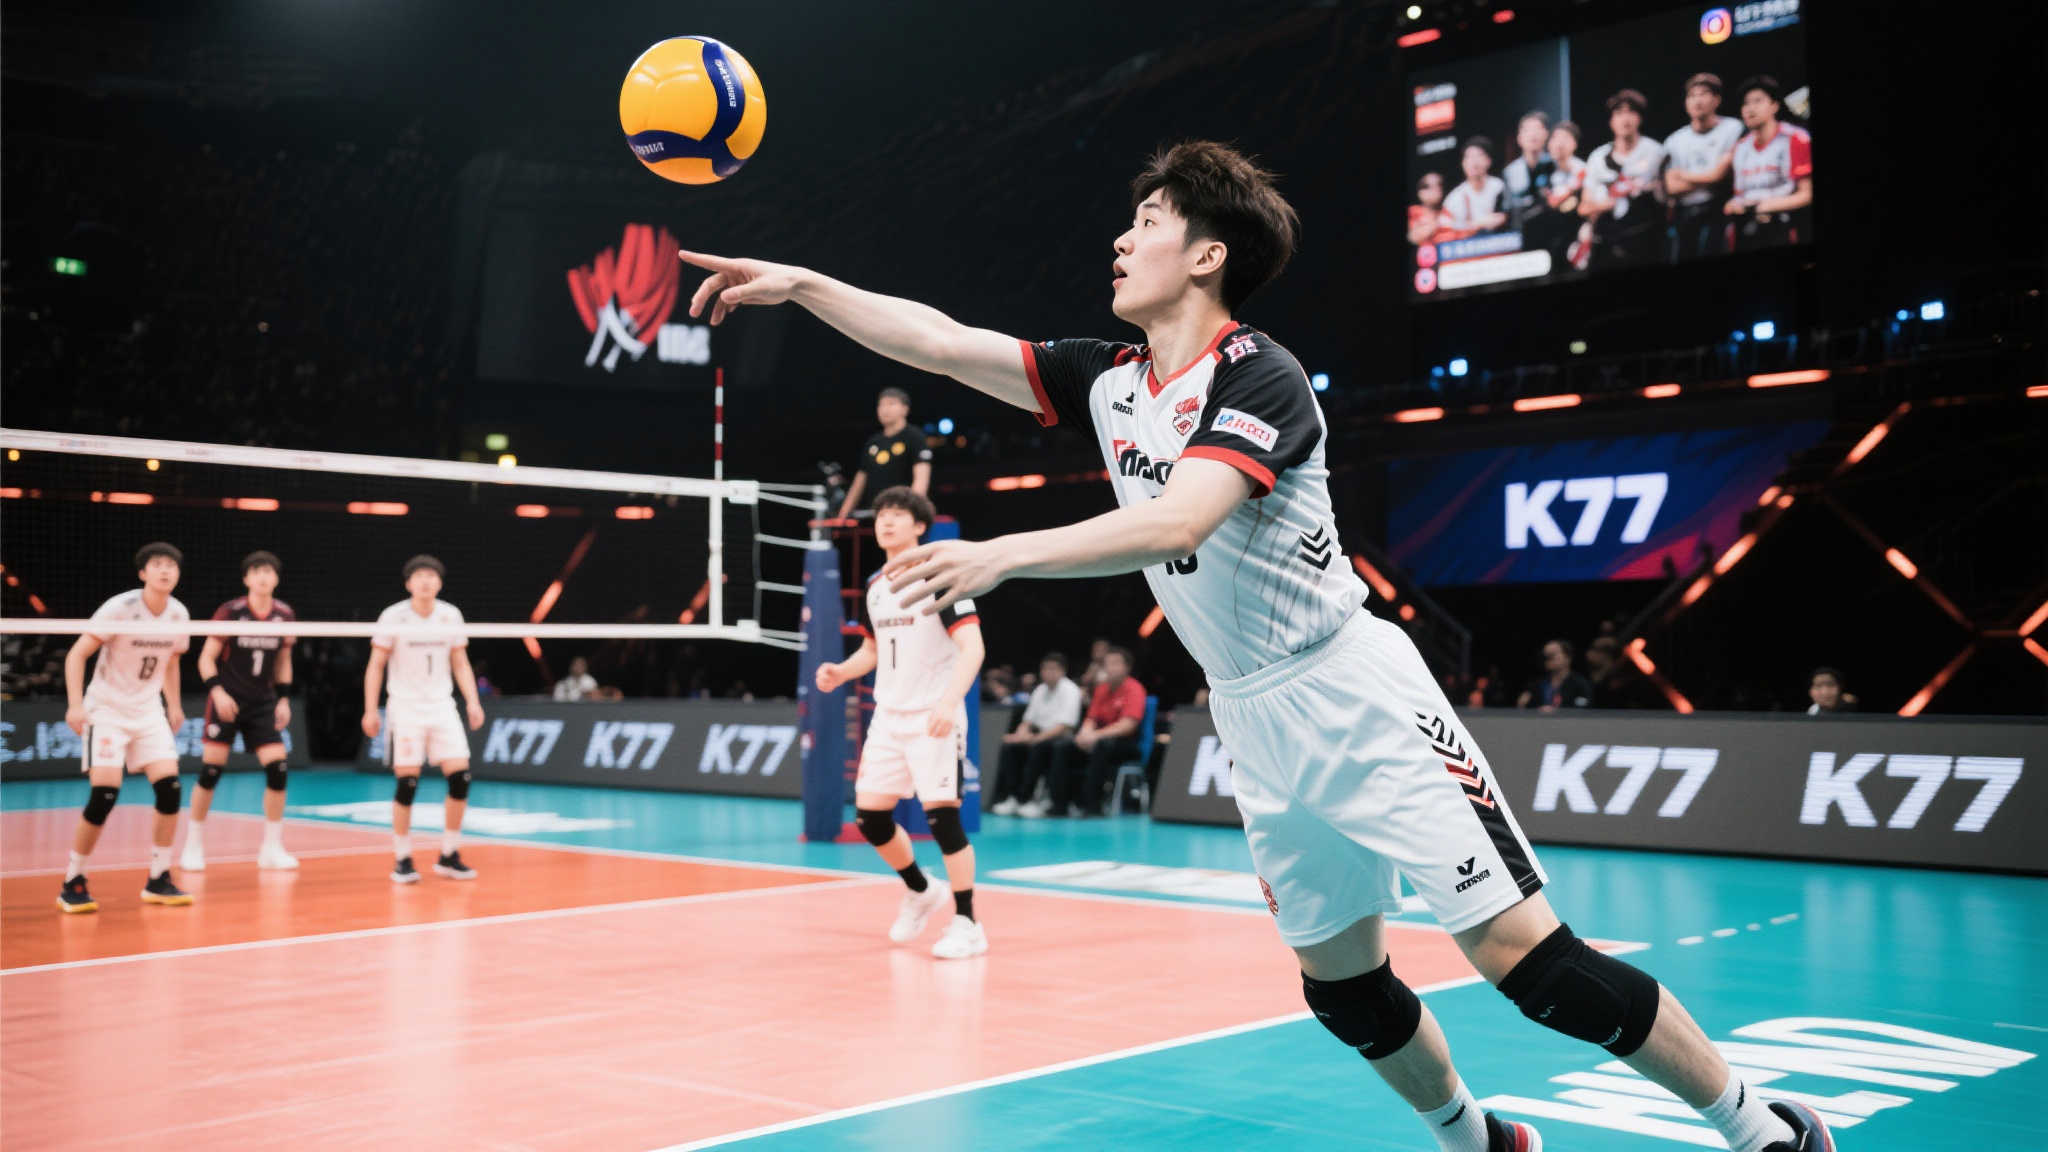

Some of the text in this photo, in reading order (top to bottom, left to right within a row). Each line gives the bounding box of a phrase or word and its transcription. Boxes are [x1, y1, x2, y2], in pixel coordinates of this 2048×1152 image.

[1505, 472, 1668, 549] K77
[252, 650, 264, 676] 1
[890, 638, 897, 669] 1
[483, 717, 564, 766] K77
[583, 721, 675, 770] K77
[698, 724, 798, 776] K77
[1533, 743, 1719, 816] K77
[1801, 751, 2025, 833] K77
